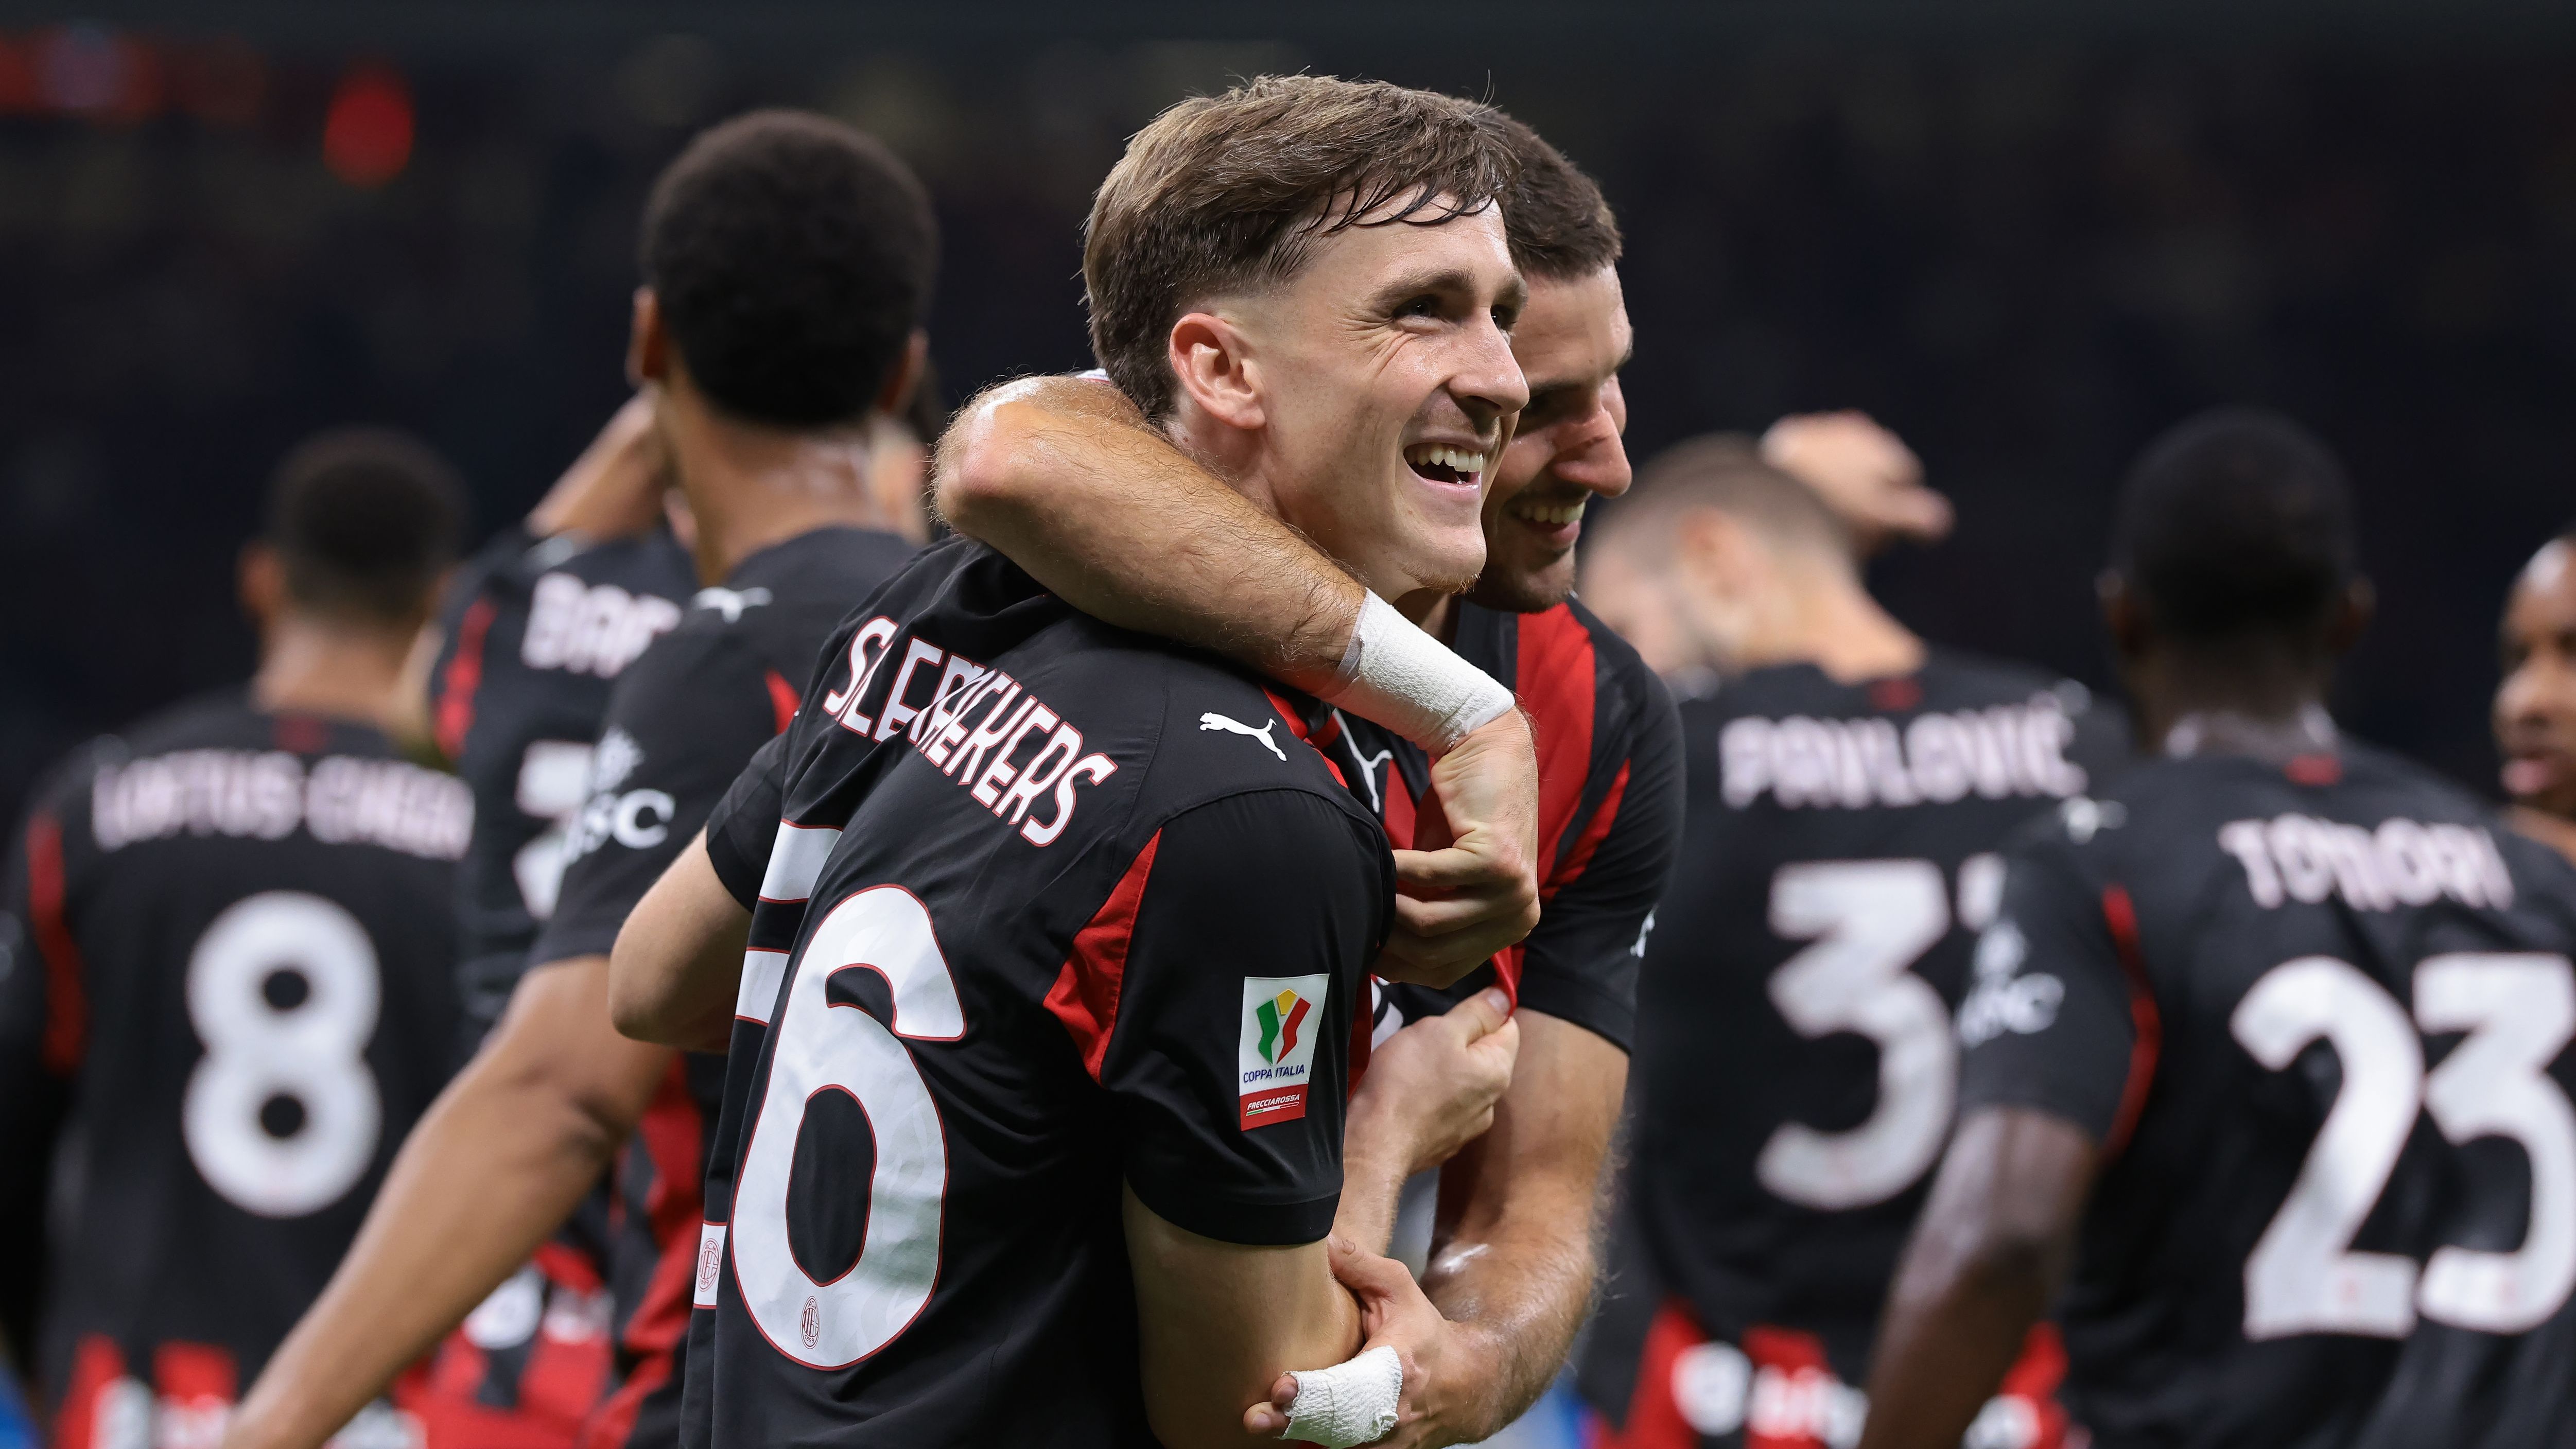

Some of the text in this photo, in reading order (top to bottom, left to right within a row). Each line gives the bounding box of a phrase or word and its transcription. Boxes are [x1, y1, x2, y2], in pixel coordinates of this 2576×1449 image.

[183, 889, 382, 1217] 8
[1244, 1064, 1304, 1083] COPPA ITALIA
[1247, 1094, 1300, 1110] FRECCIAROSSA
[2230, 952, 2576, 1339] 23
